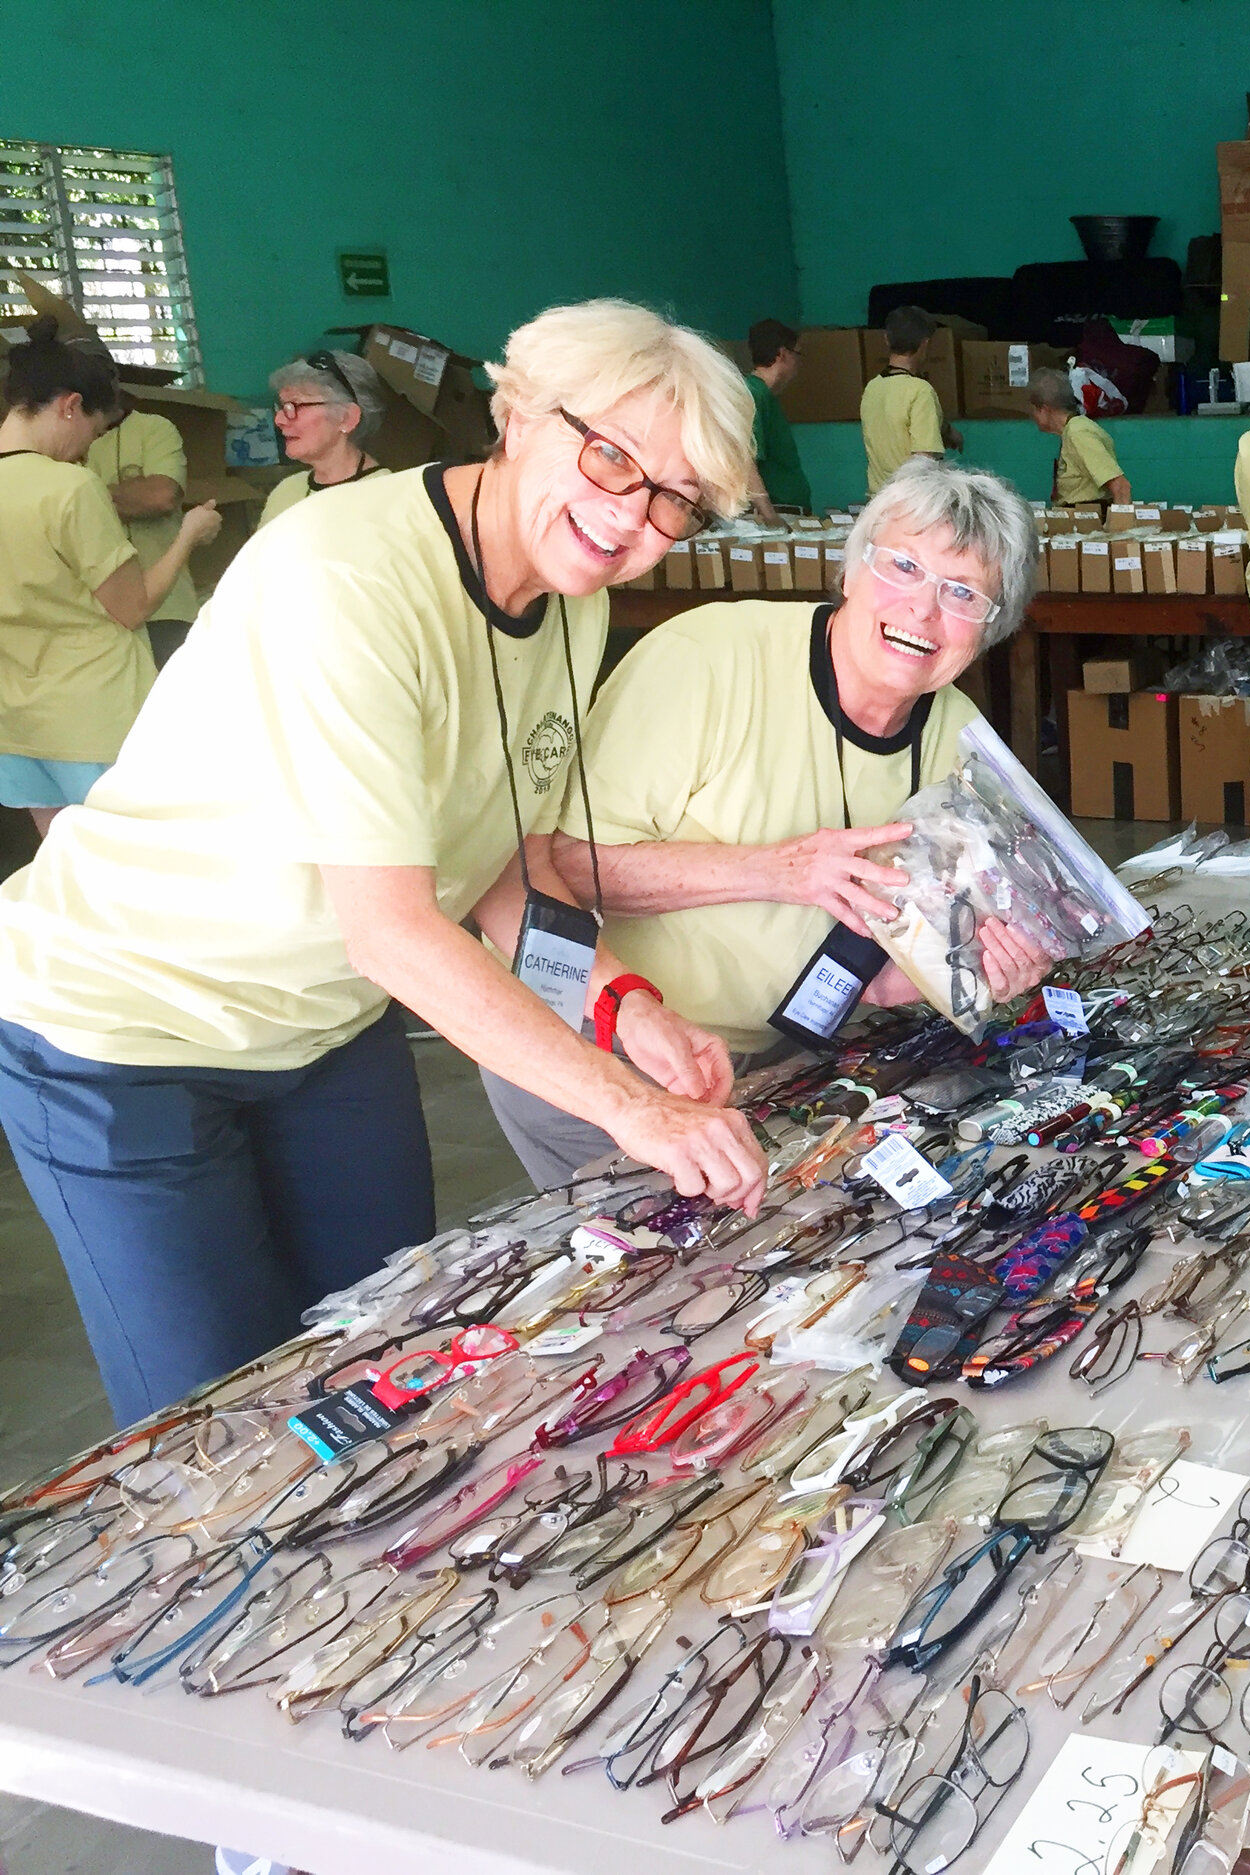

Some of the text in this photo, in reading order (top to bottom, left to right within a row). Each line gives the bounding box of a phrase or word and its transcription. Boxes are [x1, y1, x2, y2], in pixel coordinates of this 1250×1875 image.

[524, 953, 589, 984] CATHERINE
[294, 1423, 320, 1446] +2.00
[315, 1413, 353, 1446] Fashion
